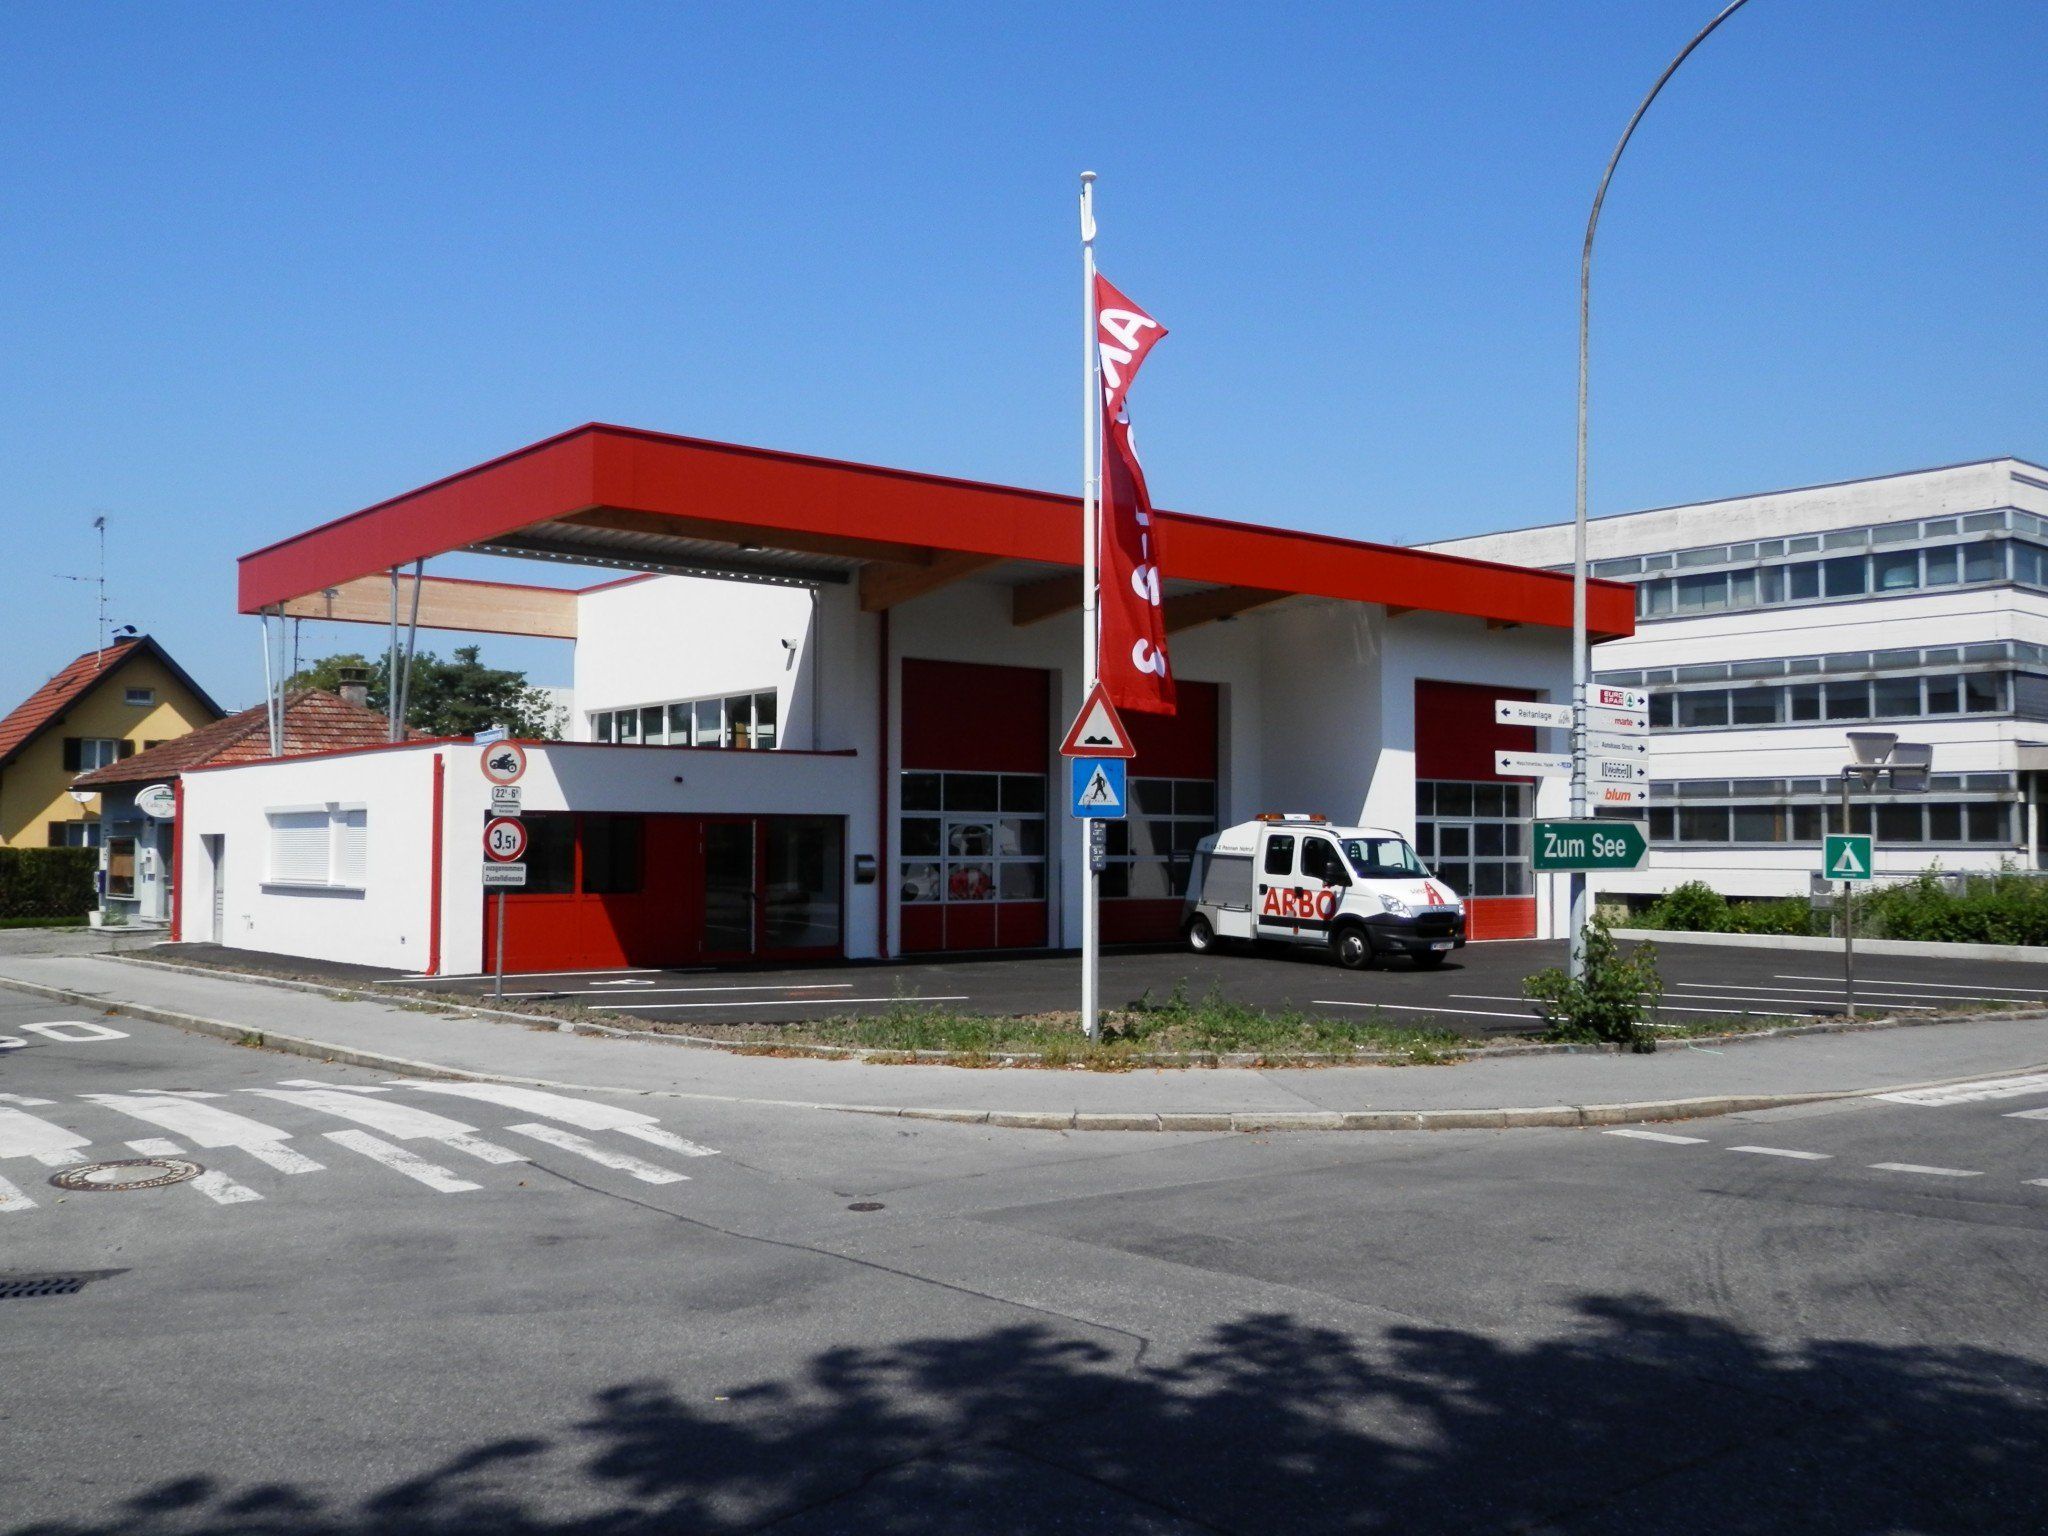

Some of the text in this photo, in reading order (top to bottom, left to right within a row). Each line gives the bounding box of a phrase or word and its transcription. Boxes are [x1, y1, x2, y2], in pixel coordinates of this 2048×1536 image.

[1518, 709, 1552, 721] Reitanlage
[1607, 766, 1627, 775] Wolford
[1605, 788, 1631, 800] blum
[1544, 832, 1626, 858] Zum See
